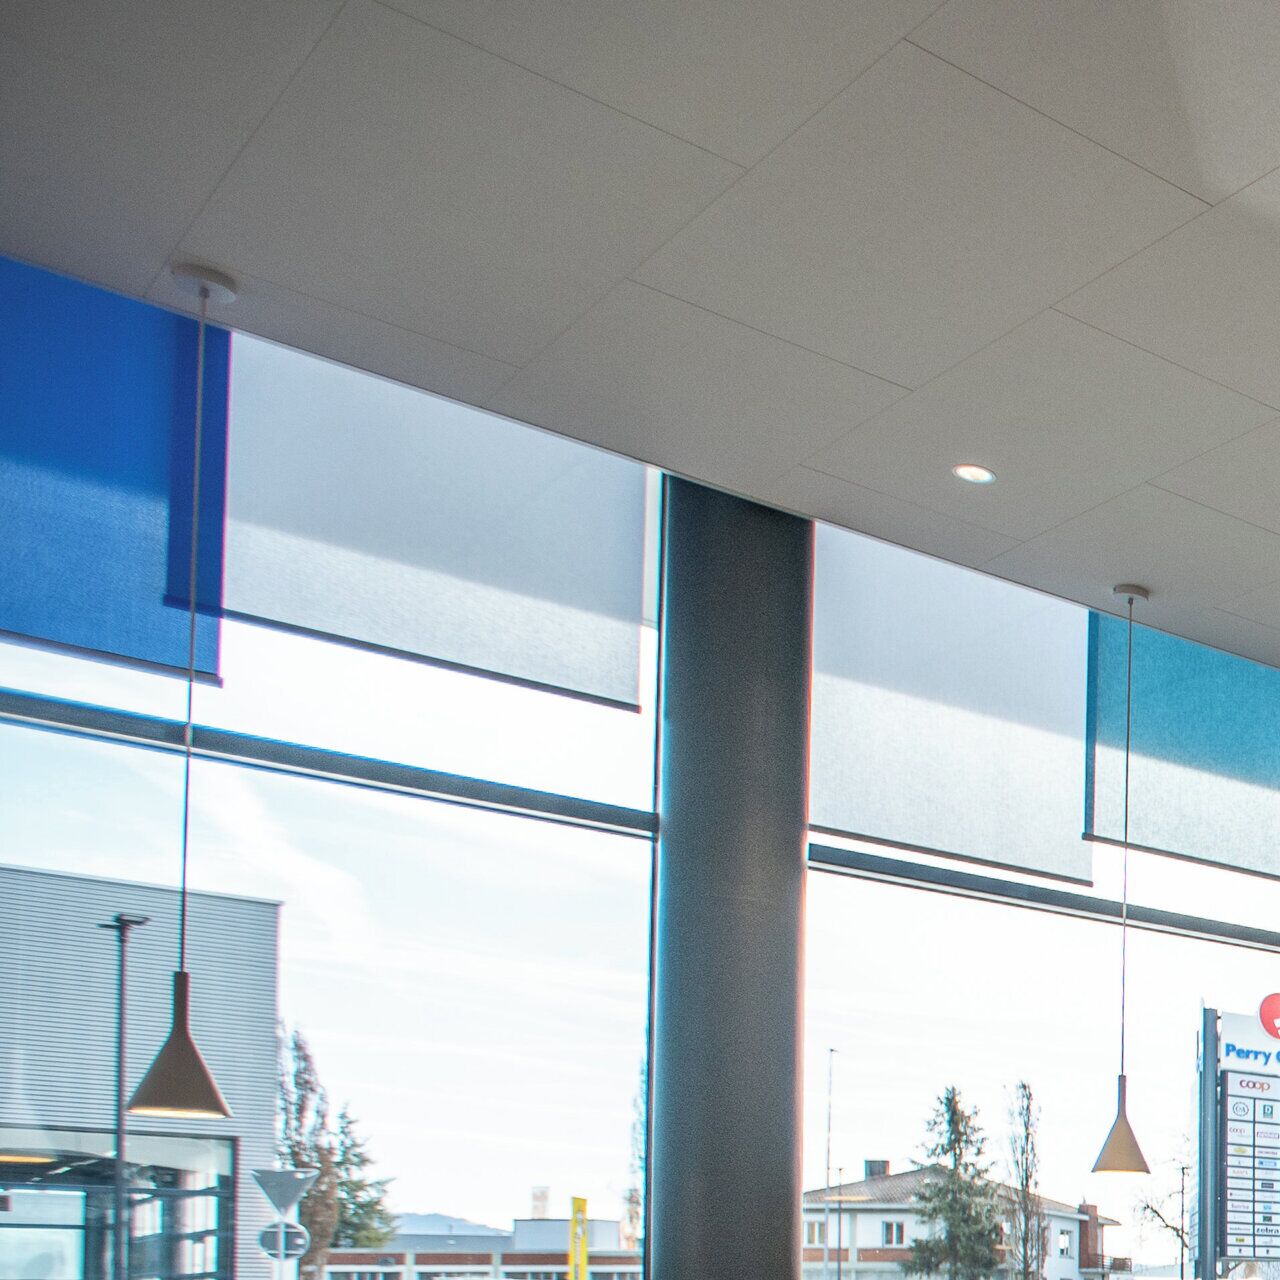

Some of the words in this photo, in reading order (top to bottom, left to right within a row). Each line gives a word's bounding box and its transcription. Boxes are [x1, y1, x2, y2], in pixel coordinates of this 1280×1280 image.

[1225, 1043, 1271, 1066] Perry
[1240, 1079, 1270, 1093] coop
[1256, 1224, 1280, 1234] zebra
